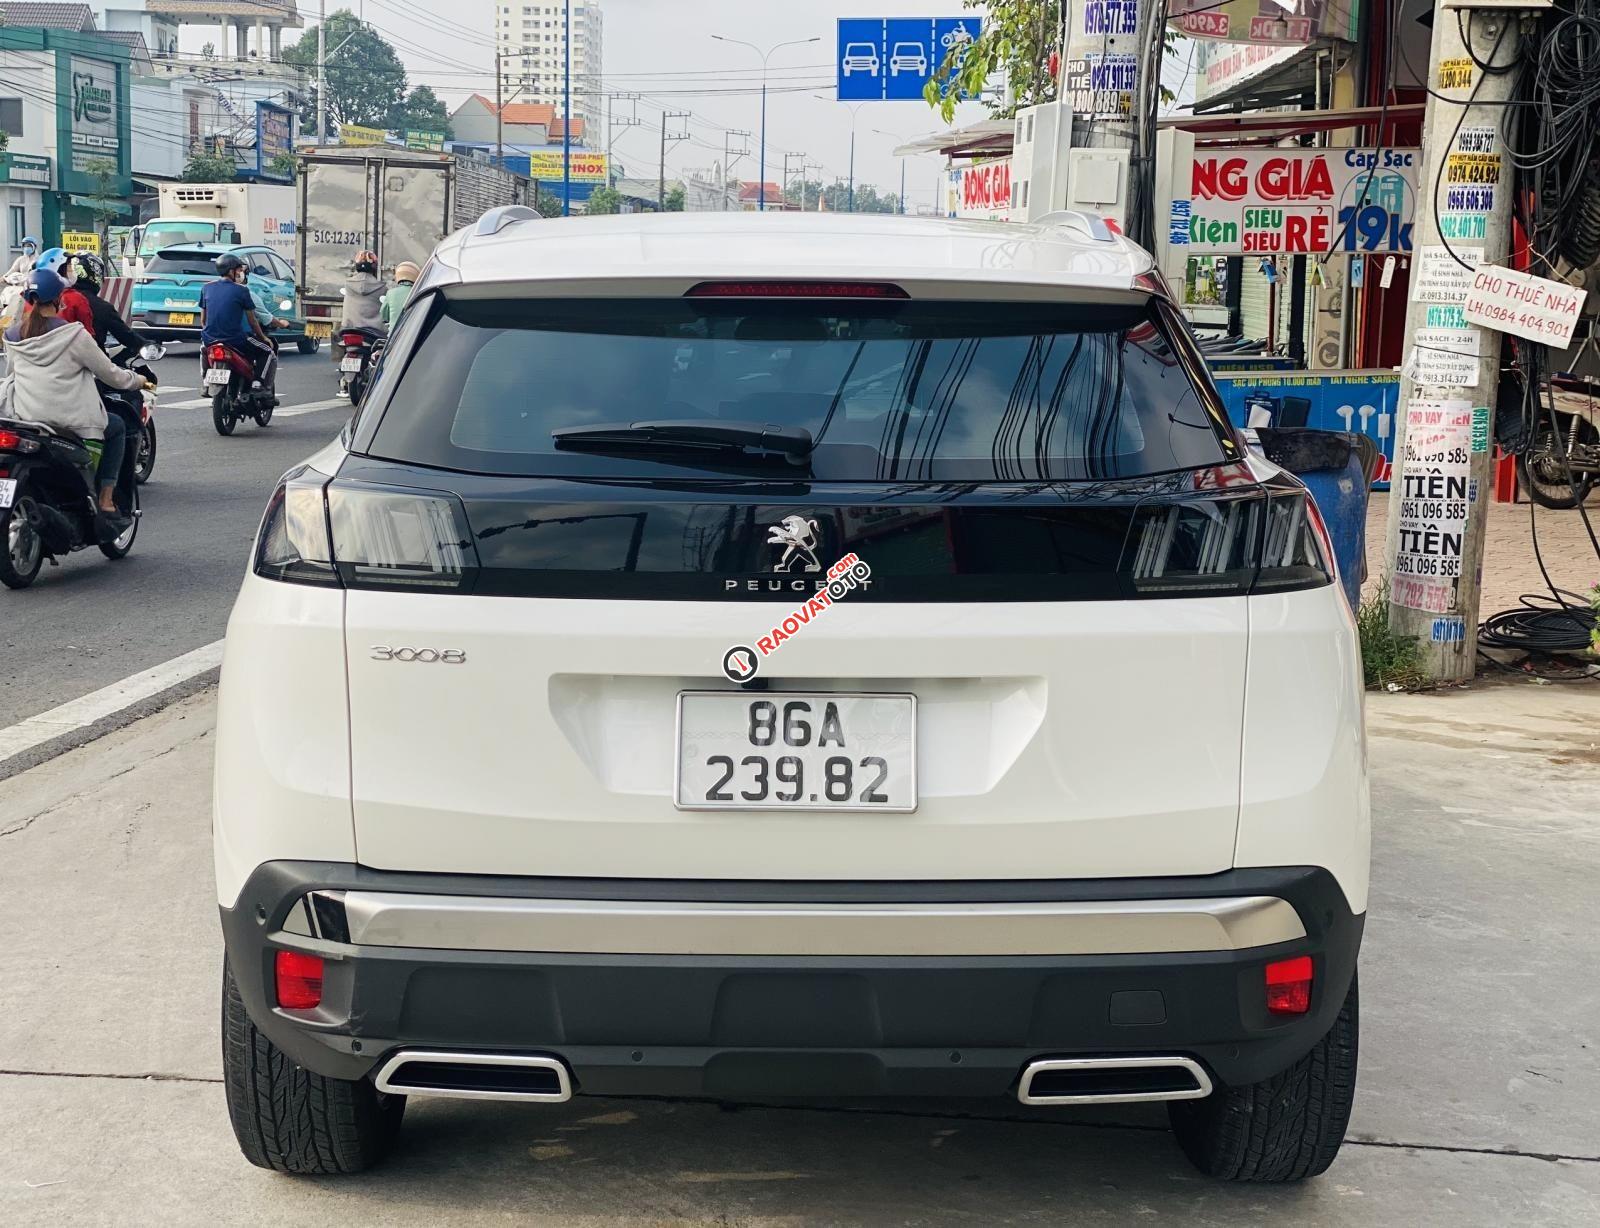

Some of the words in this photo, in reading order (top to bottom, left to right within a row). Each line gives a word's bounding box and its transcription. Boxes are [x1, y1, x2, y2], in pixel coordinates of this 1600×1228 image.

[573, 164, 604, 173] INOX
[1344, 150, 1380, 169] Cáp
[1384, 150, 1413, 169] Sạc
[1255, 154, 1335, 201] GIÁ
[1448, 165, 1500, 184] 0974.424.924
[264, 218, 278, 232] ABA
[1244, 207, 1283, 229] SIÊU
[1285, 206, 1330, 252] RẺ
[1338, 205, 1415, 252] 19k
[1243, 231, 1281, 251] SIÊU
[1474, 272, 1502, 294] CHO
[1506, 284, 1546, 306] THUÊ
[1544, 294, 1578, 315] NHÀ
[1425, 412, 1443, 424] VAY
[1403, 467, 1467, 499] TIỀN
[1401, 502, 1420, 519] 0961
[1422, 502, 1443, 519] 096
[1445, 503, 1466, 520] 585
[1399, 522, 1462, 556] TIỀN
[1396, 555, 1414, 573] 0961
[1416, 557, 1437, 576] 096
[1440, 559, 1460, 576] 585
[725, 580, 873, 591] PEUGET
[370, 645, 467, 664] 3008
[748, 701, 846, 748] 86A
[705, 755, 889, 803] 239.82
